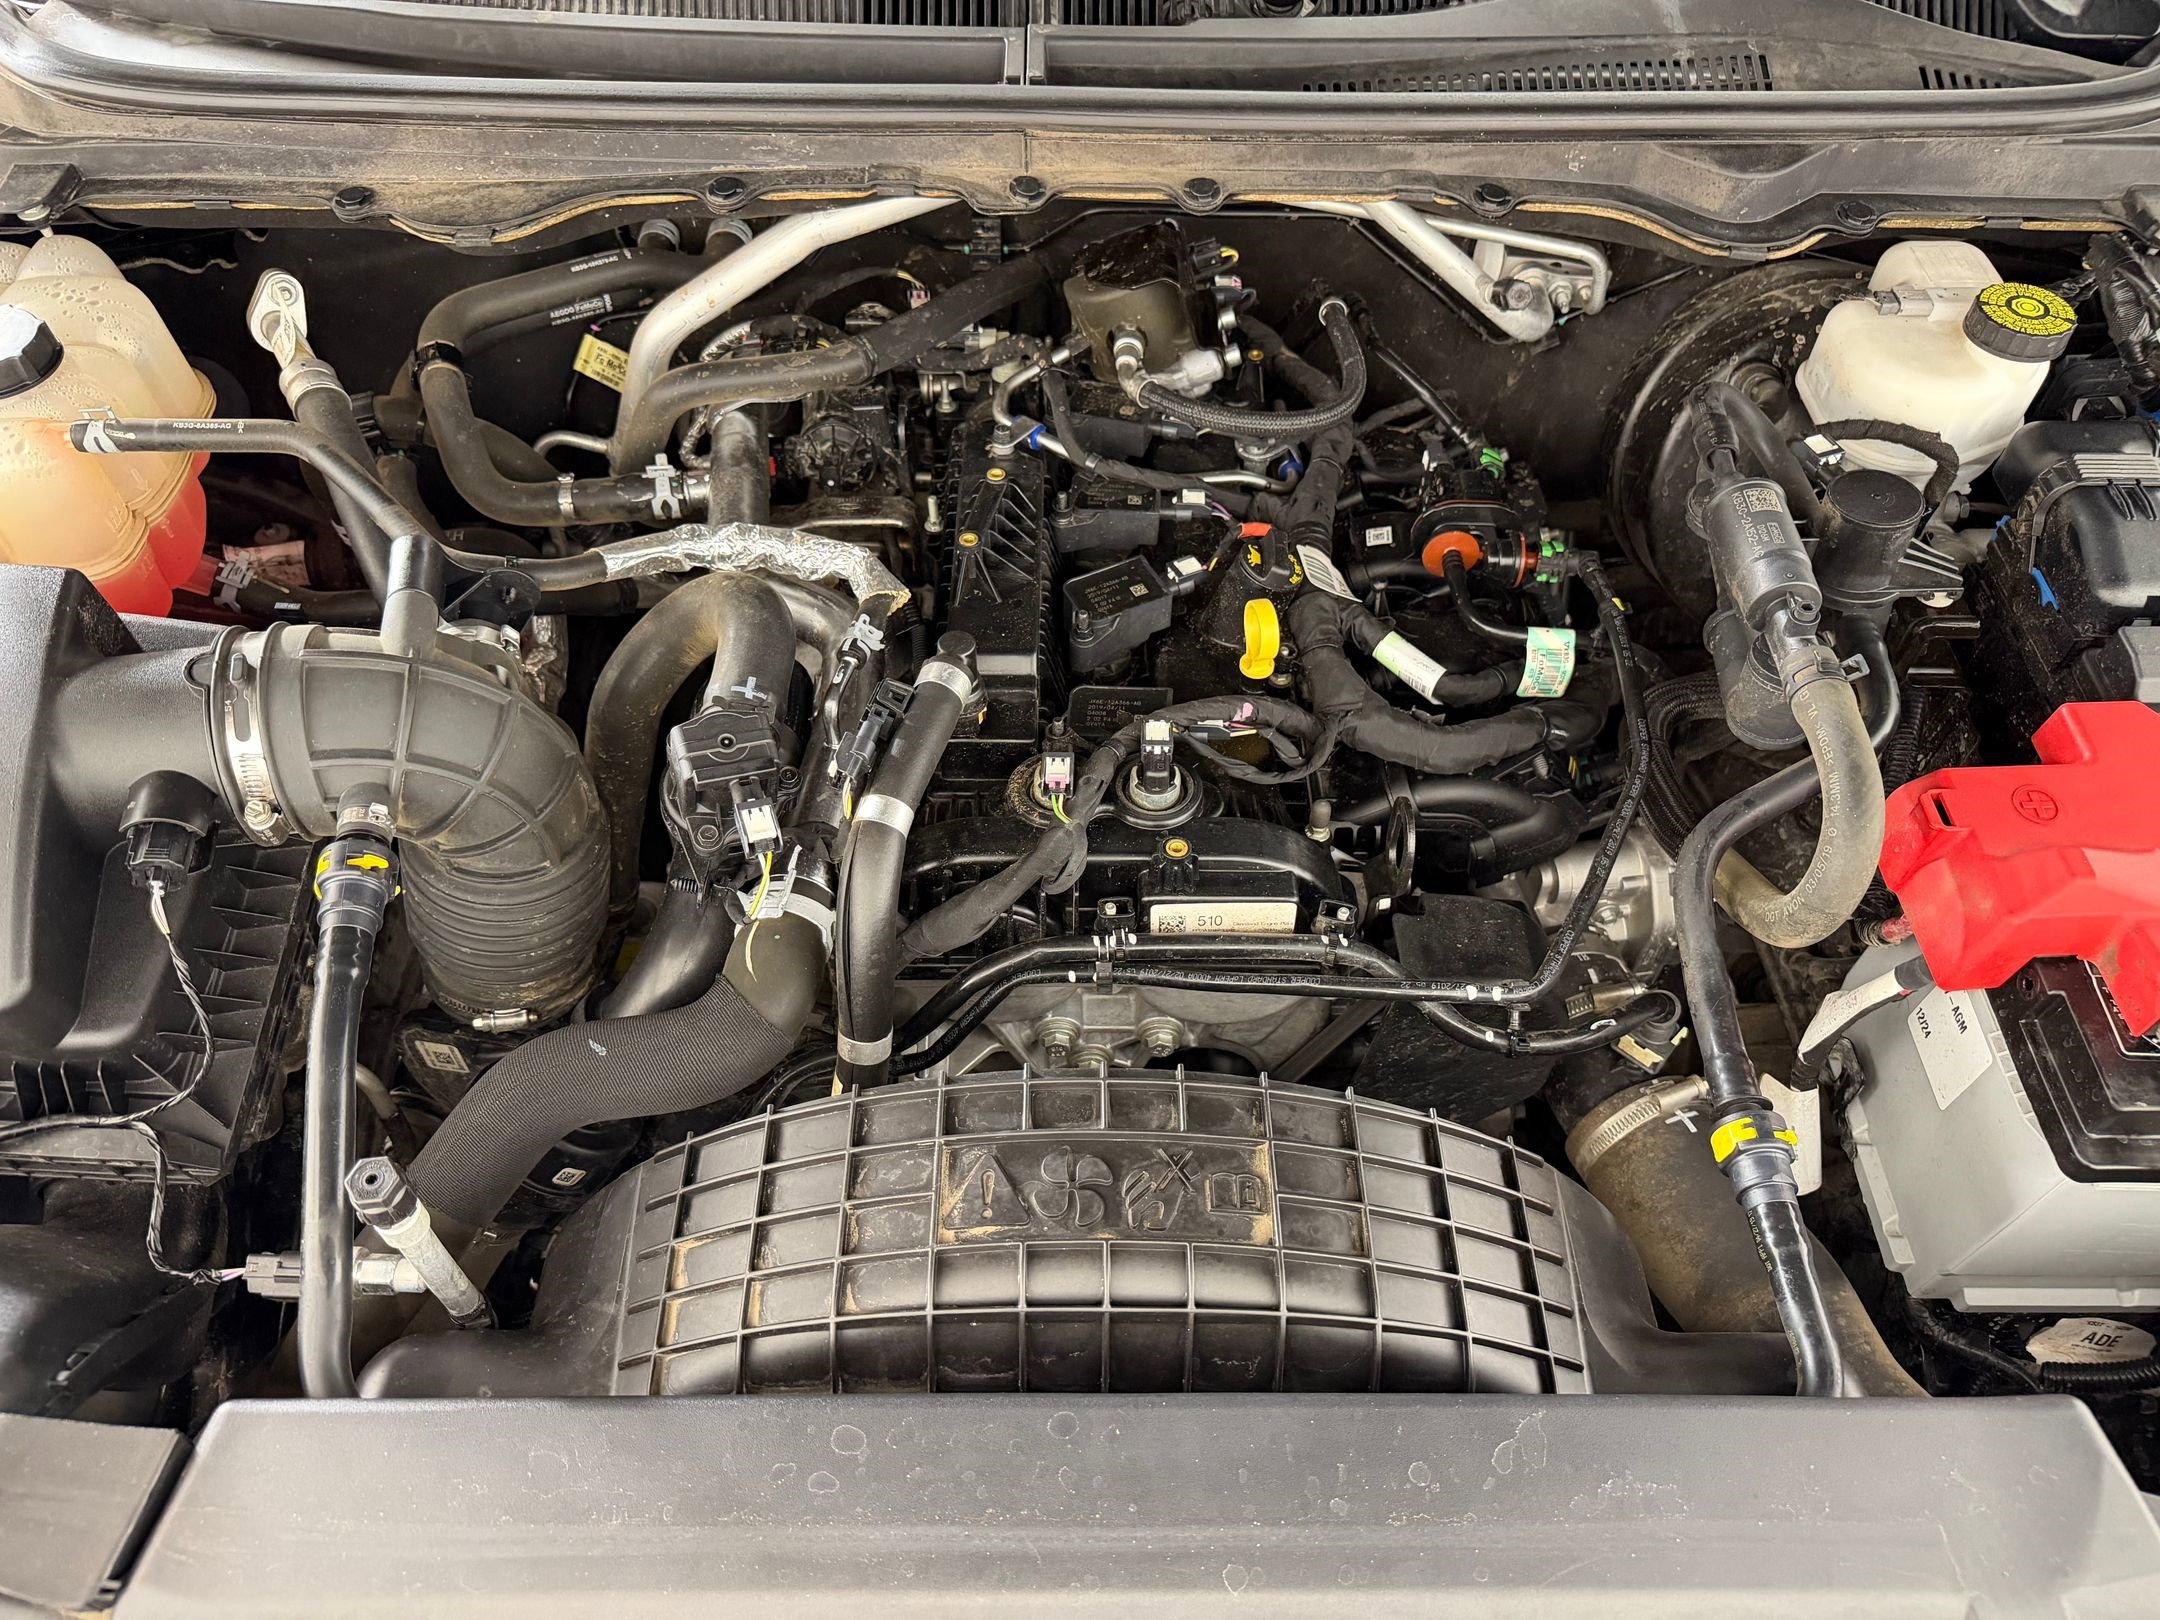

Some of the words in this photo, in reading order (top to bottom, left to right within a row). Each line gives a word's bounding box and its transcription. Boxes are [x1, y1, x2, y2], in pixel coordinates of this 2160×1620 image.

[1531, 652, 1546, 691] FoMoCo
[1637, 718, 1649, 742] COOPER
[1783, 892, 1805, 918] AVON
[1805, 845, 1833, 894] 03/05/19
[1829, 771, 1841, 818] 14.3MM
[1197, 915, 1223, 927] 510
[1559, 930, 1575, 954] COOPER
[1012, 968, 1041, 981] COOPER
[1139, 968, 1185, 979] 02/27/2019
[1249, 975, 1287, 985] STANDARD
[1291, 975, 1321, 987] COOPER
[1400, 981, 1413, 989] 22
[1915, 1007, 1932, 1039] 12/24
[2080, 1331, 2124, 1348] ADE
